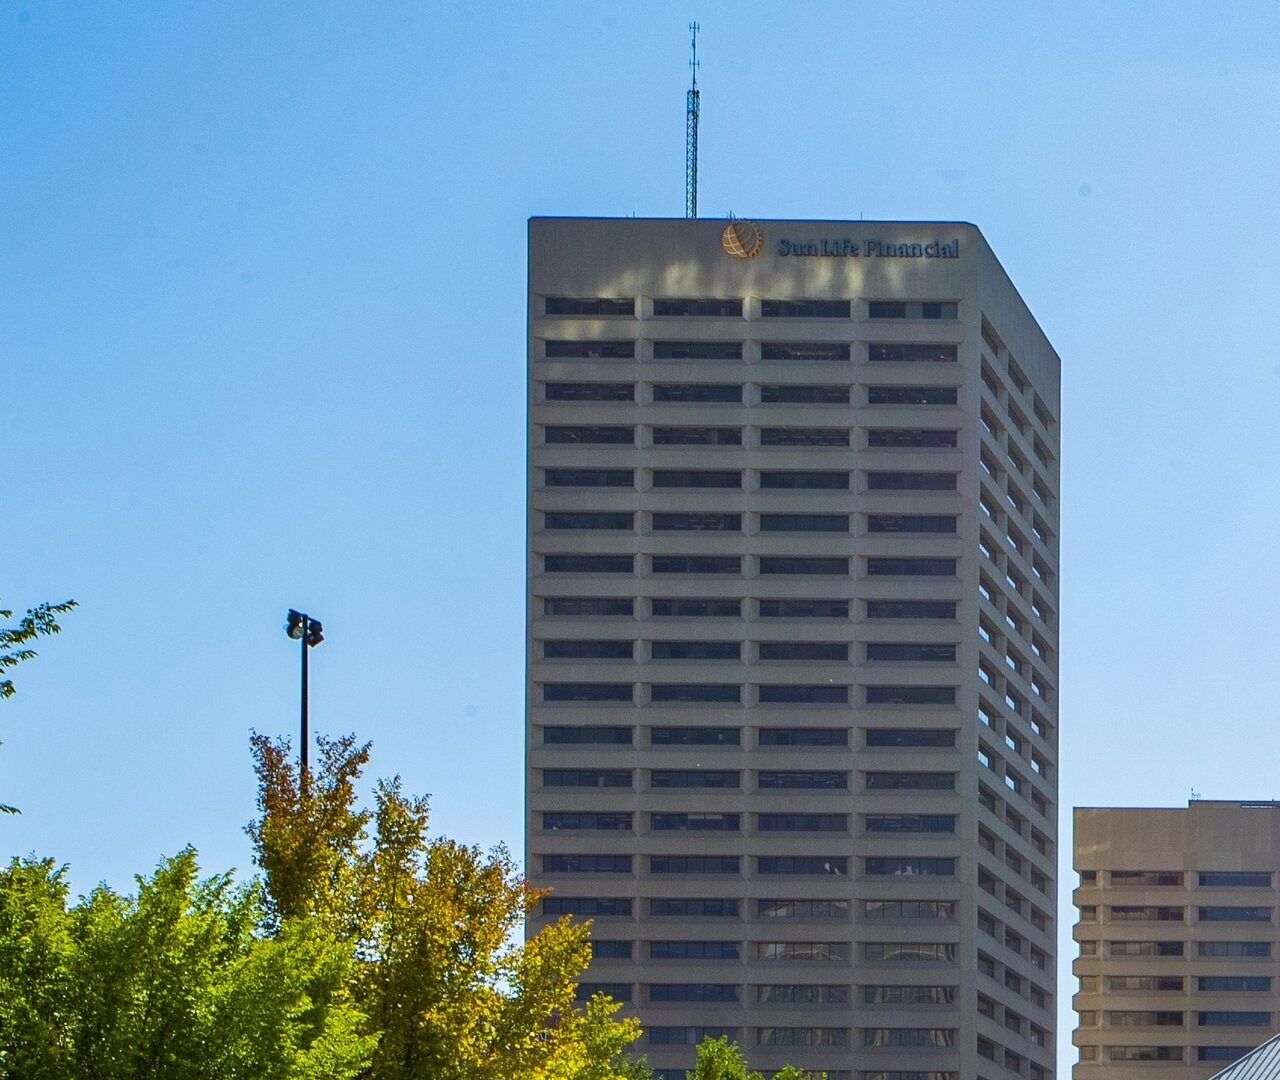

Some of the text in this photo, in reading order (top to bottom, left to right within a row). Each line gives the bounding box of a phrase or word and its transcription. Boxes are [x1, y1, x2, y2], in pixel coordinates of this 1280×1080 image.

[777, 238, 960, 259] Sun Life Financial
